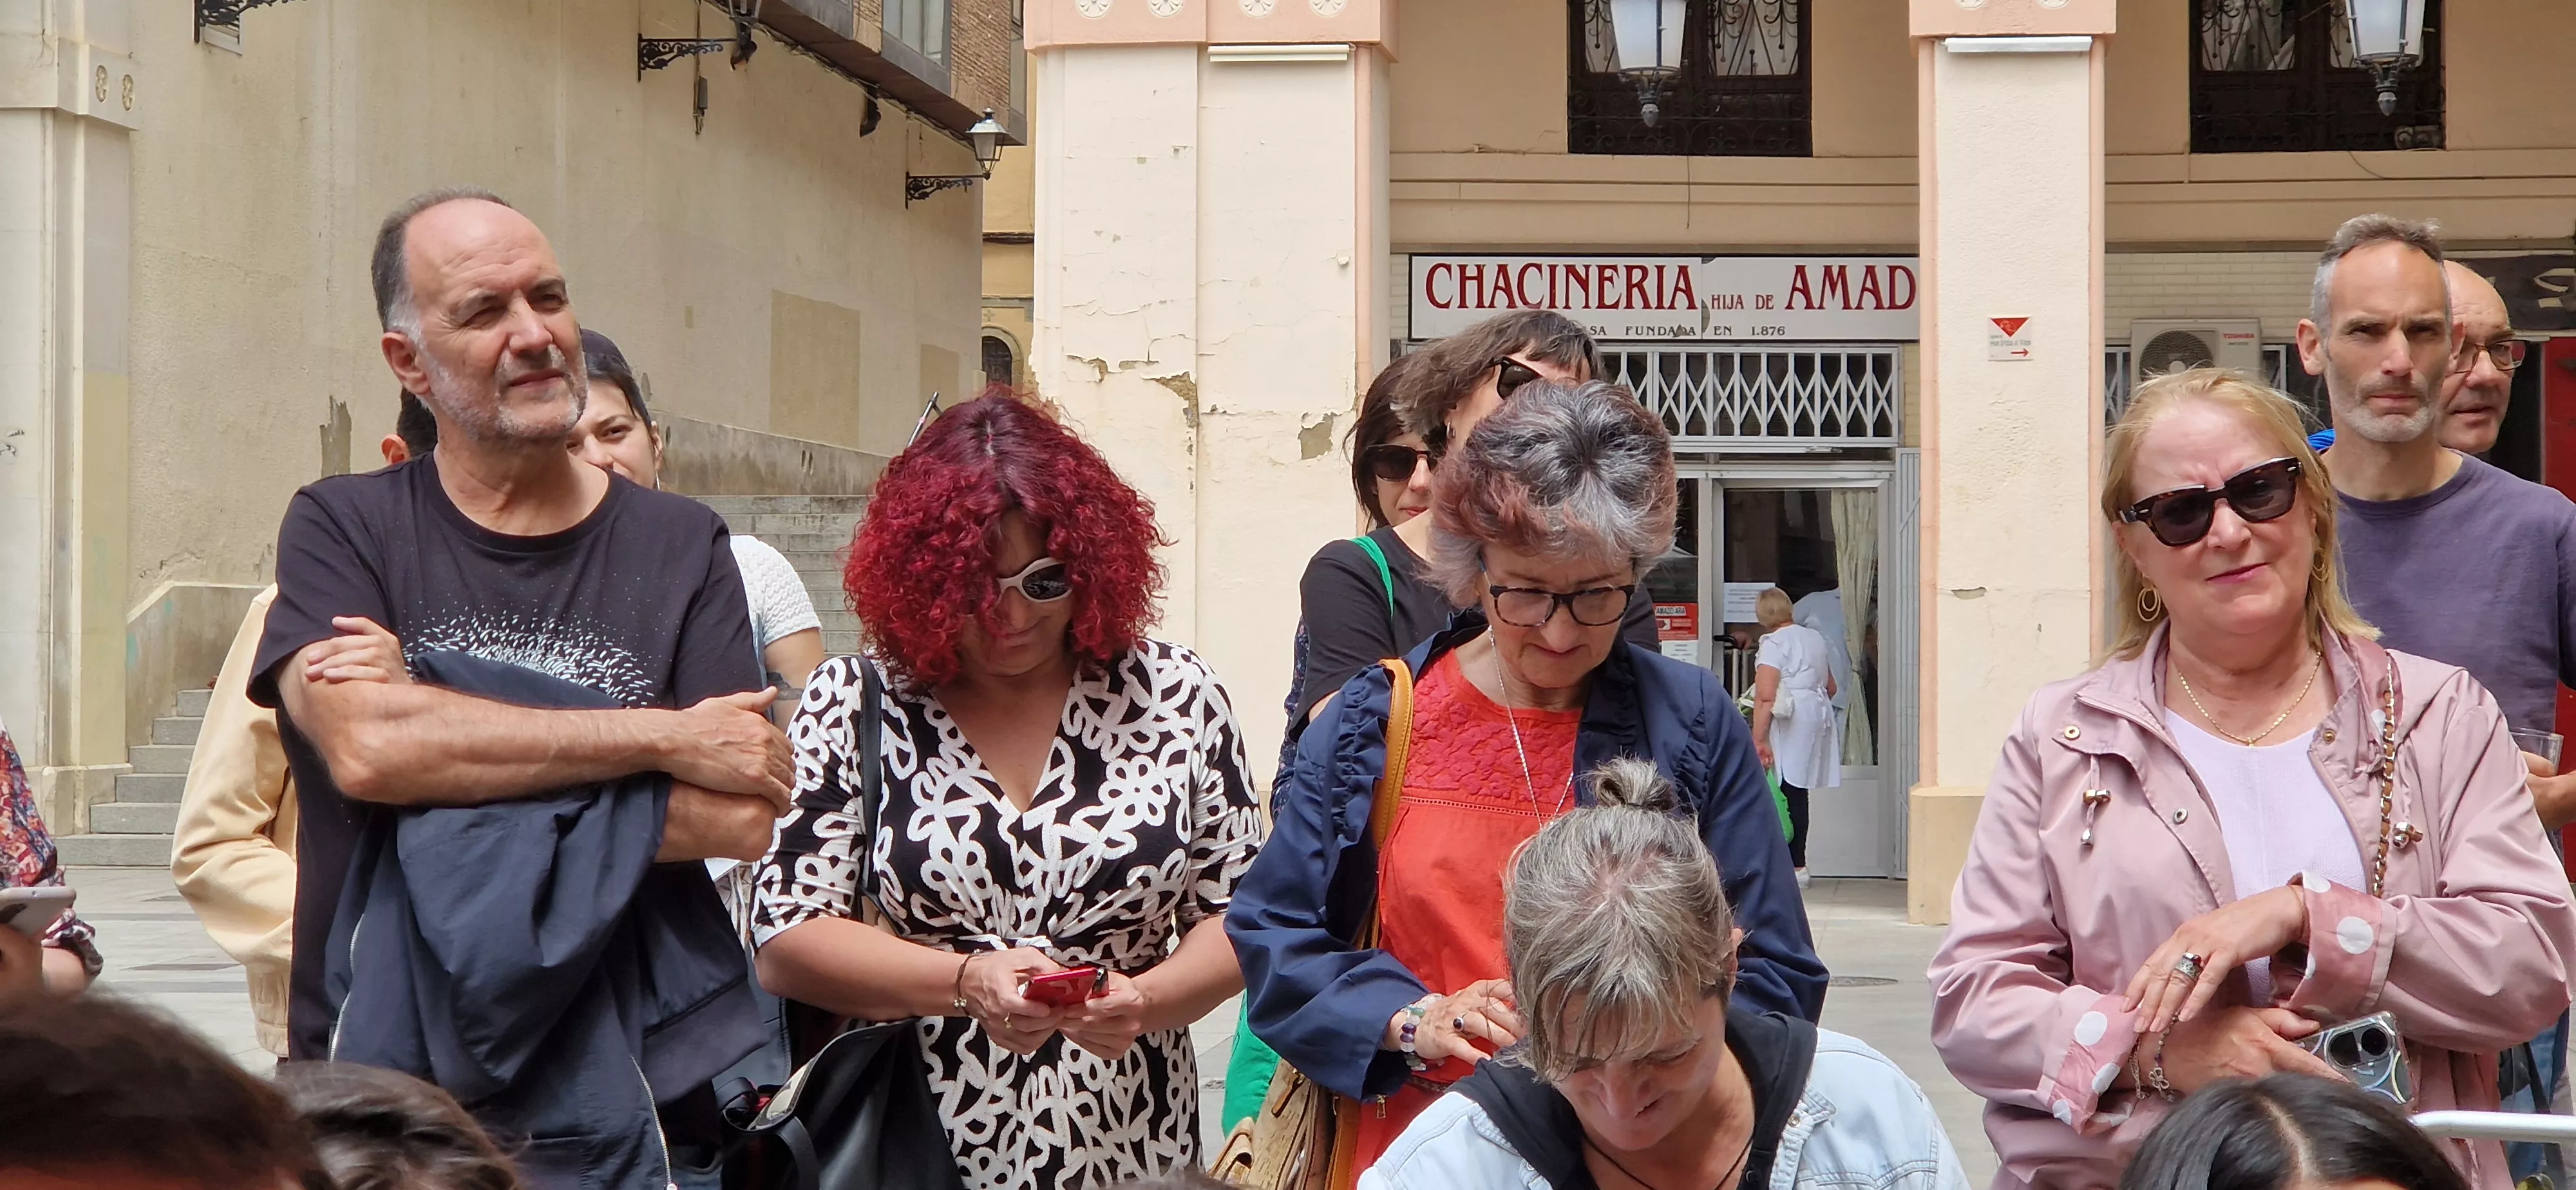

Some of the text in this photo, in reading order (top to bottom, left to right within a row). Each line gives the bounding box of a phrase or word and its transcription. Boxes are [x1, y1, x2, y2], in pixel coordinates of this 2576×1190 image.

[1425, 262, 1698, 310] CHACINERIA
[1710, 294, 1745, 310] HIJA
[1755, 294, 1774, 310] DE
[1713, 325, 1732, 335] EN
[1751, 326, 1786, 336] 1.876
